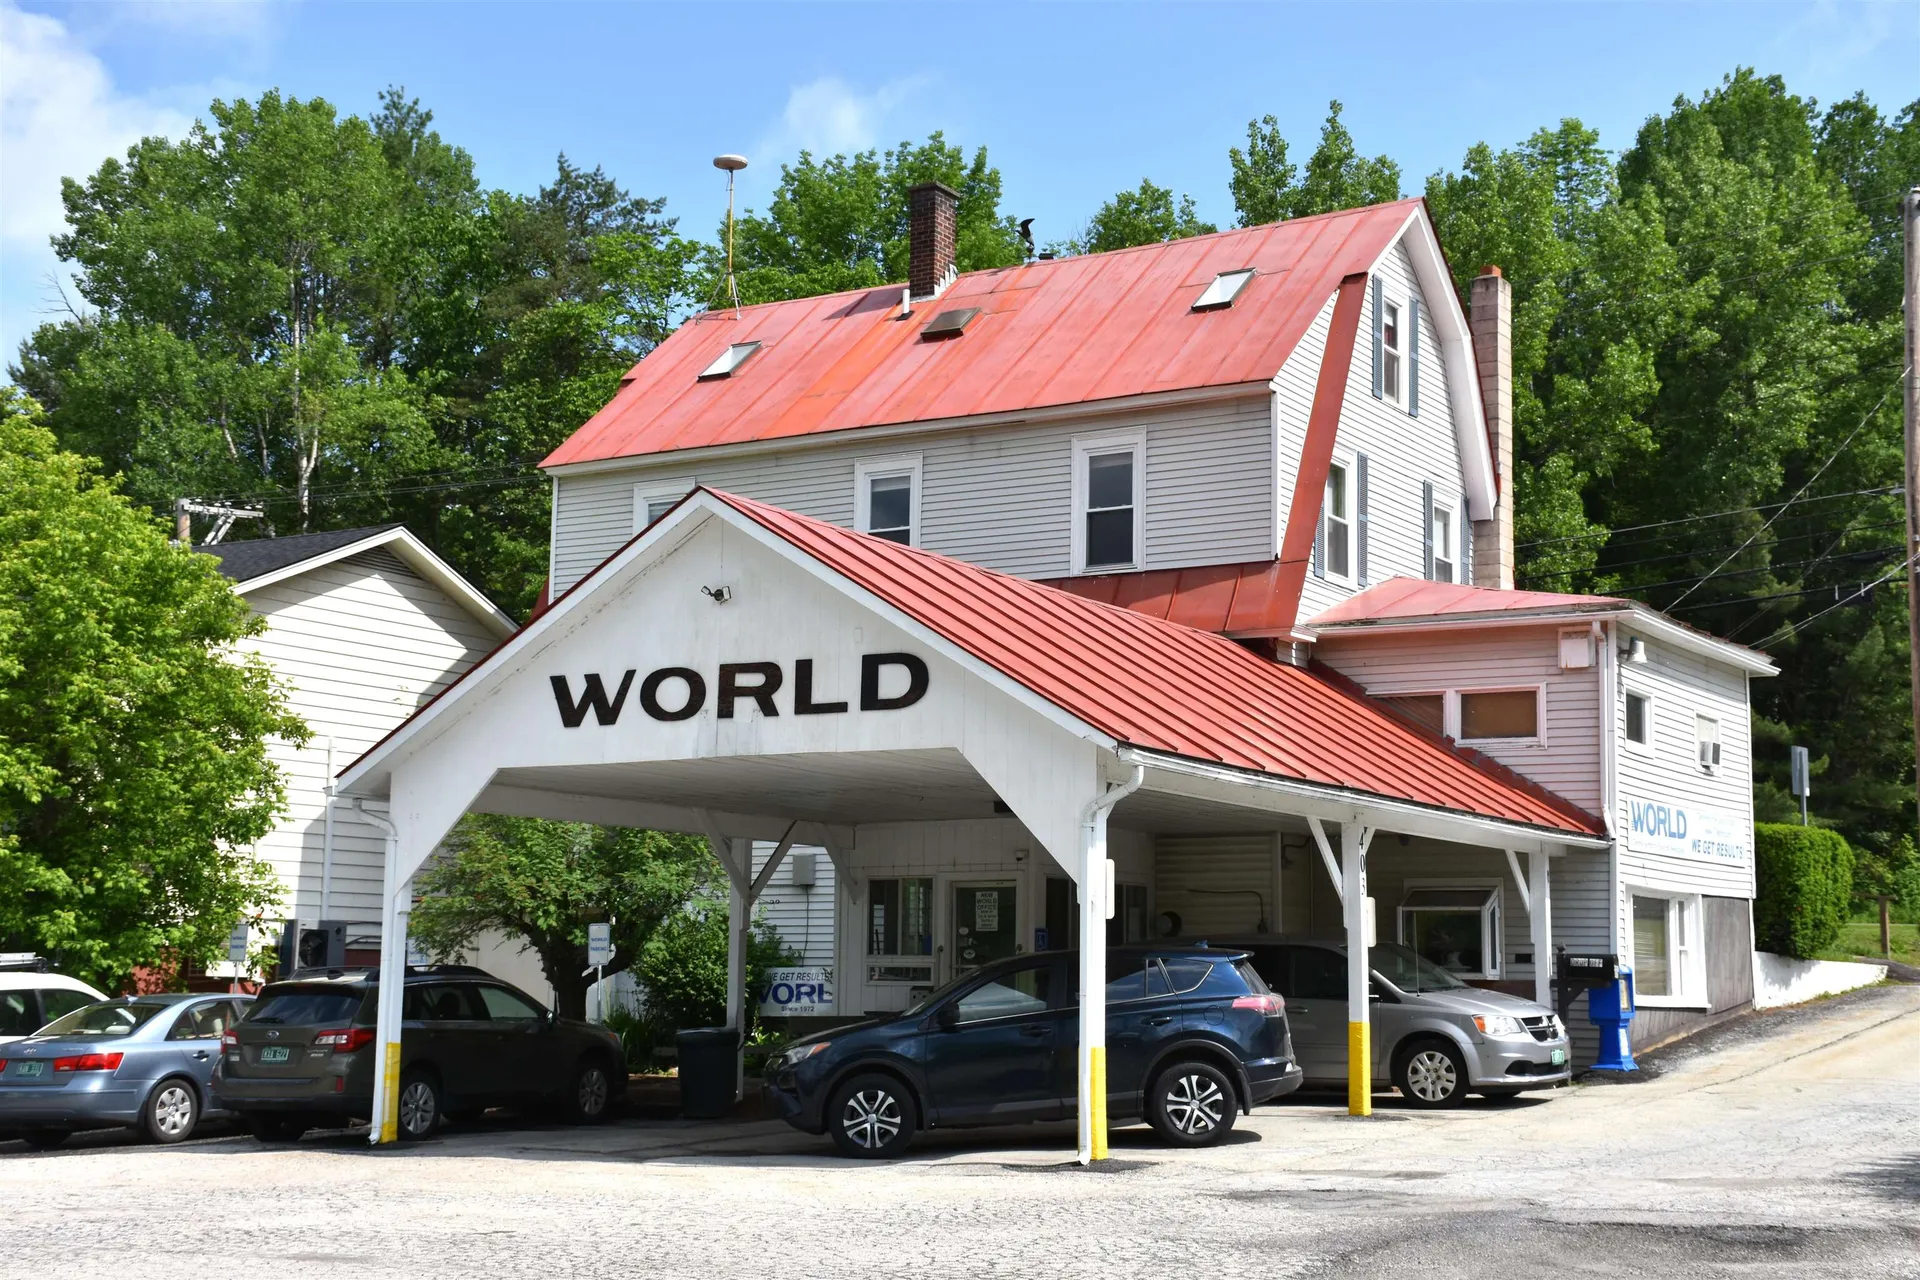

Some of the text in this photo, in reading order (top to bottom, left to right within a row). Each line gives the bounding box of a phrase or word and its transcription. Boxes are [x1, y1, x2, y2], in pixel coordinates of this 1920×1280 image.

[549, 652, 929, 728] WORLD
[1631, 800, 1687, 839] WORLD
[1692, 839, 1701, 853] WE
[1703, 840, 1715, 855] GET
[780, 972, 796, 981] GET
